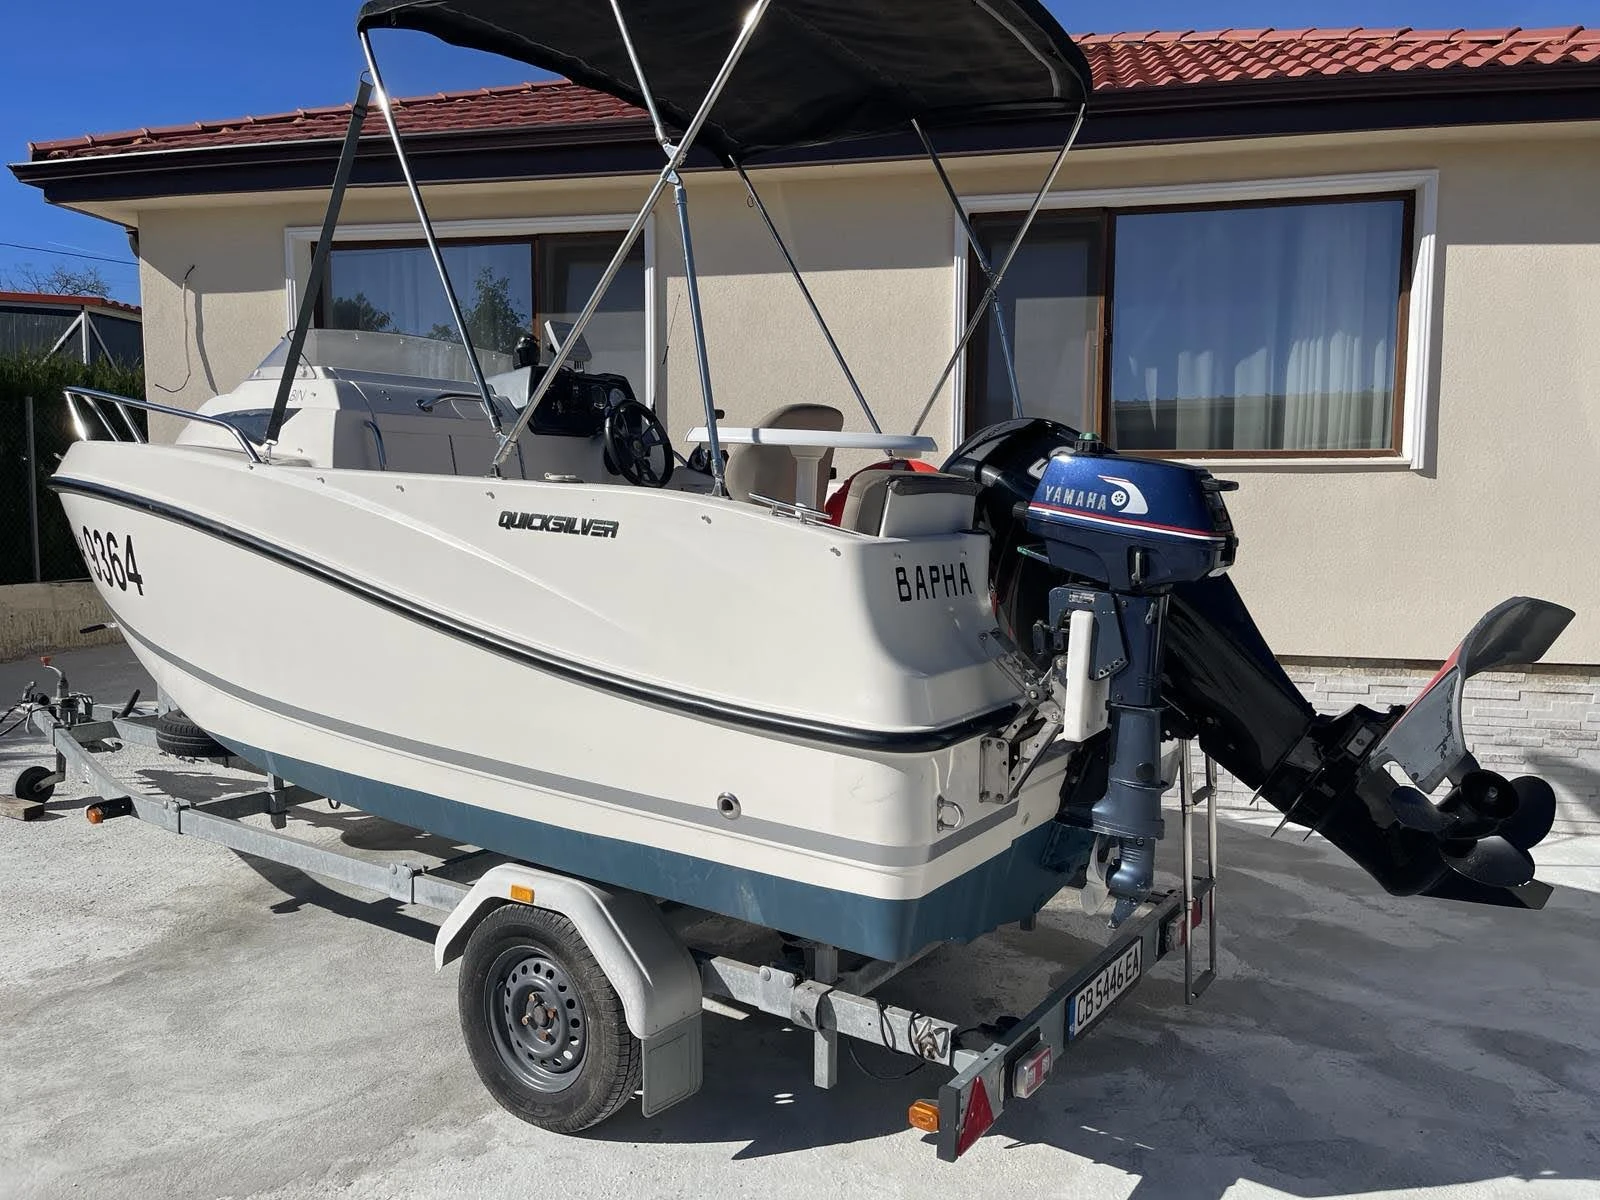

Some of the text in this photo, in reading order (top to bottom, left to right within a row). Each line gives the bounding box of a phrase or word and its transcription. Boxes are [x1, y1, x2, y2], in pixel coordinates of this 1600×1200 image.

[1045, 485, 1107, 511] YAMAHA
[498, 510, 620, 539] QUICKSILVER
[82, 525, 144, 597] 9364
[895, 562, 973, 602] ВАРНА
[1077, 946, 1139, 1027] CB 5446 EA
